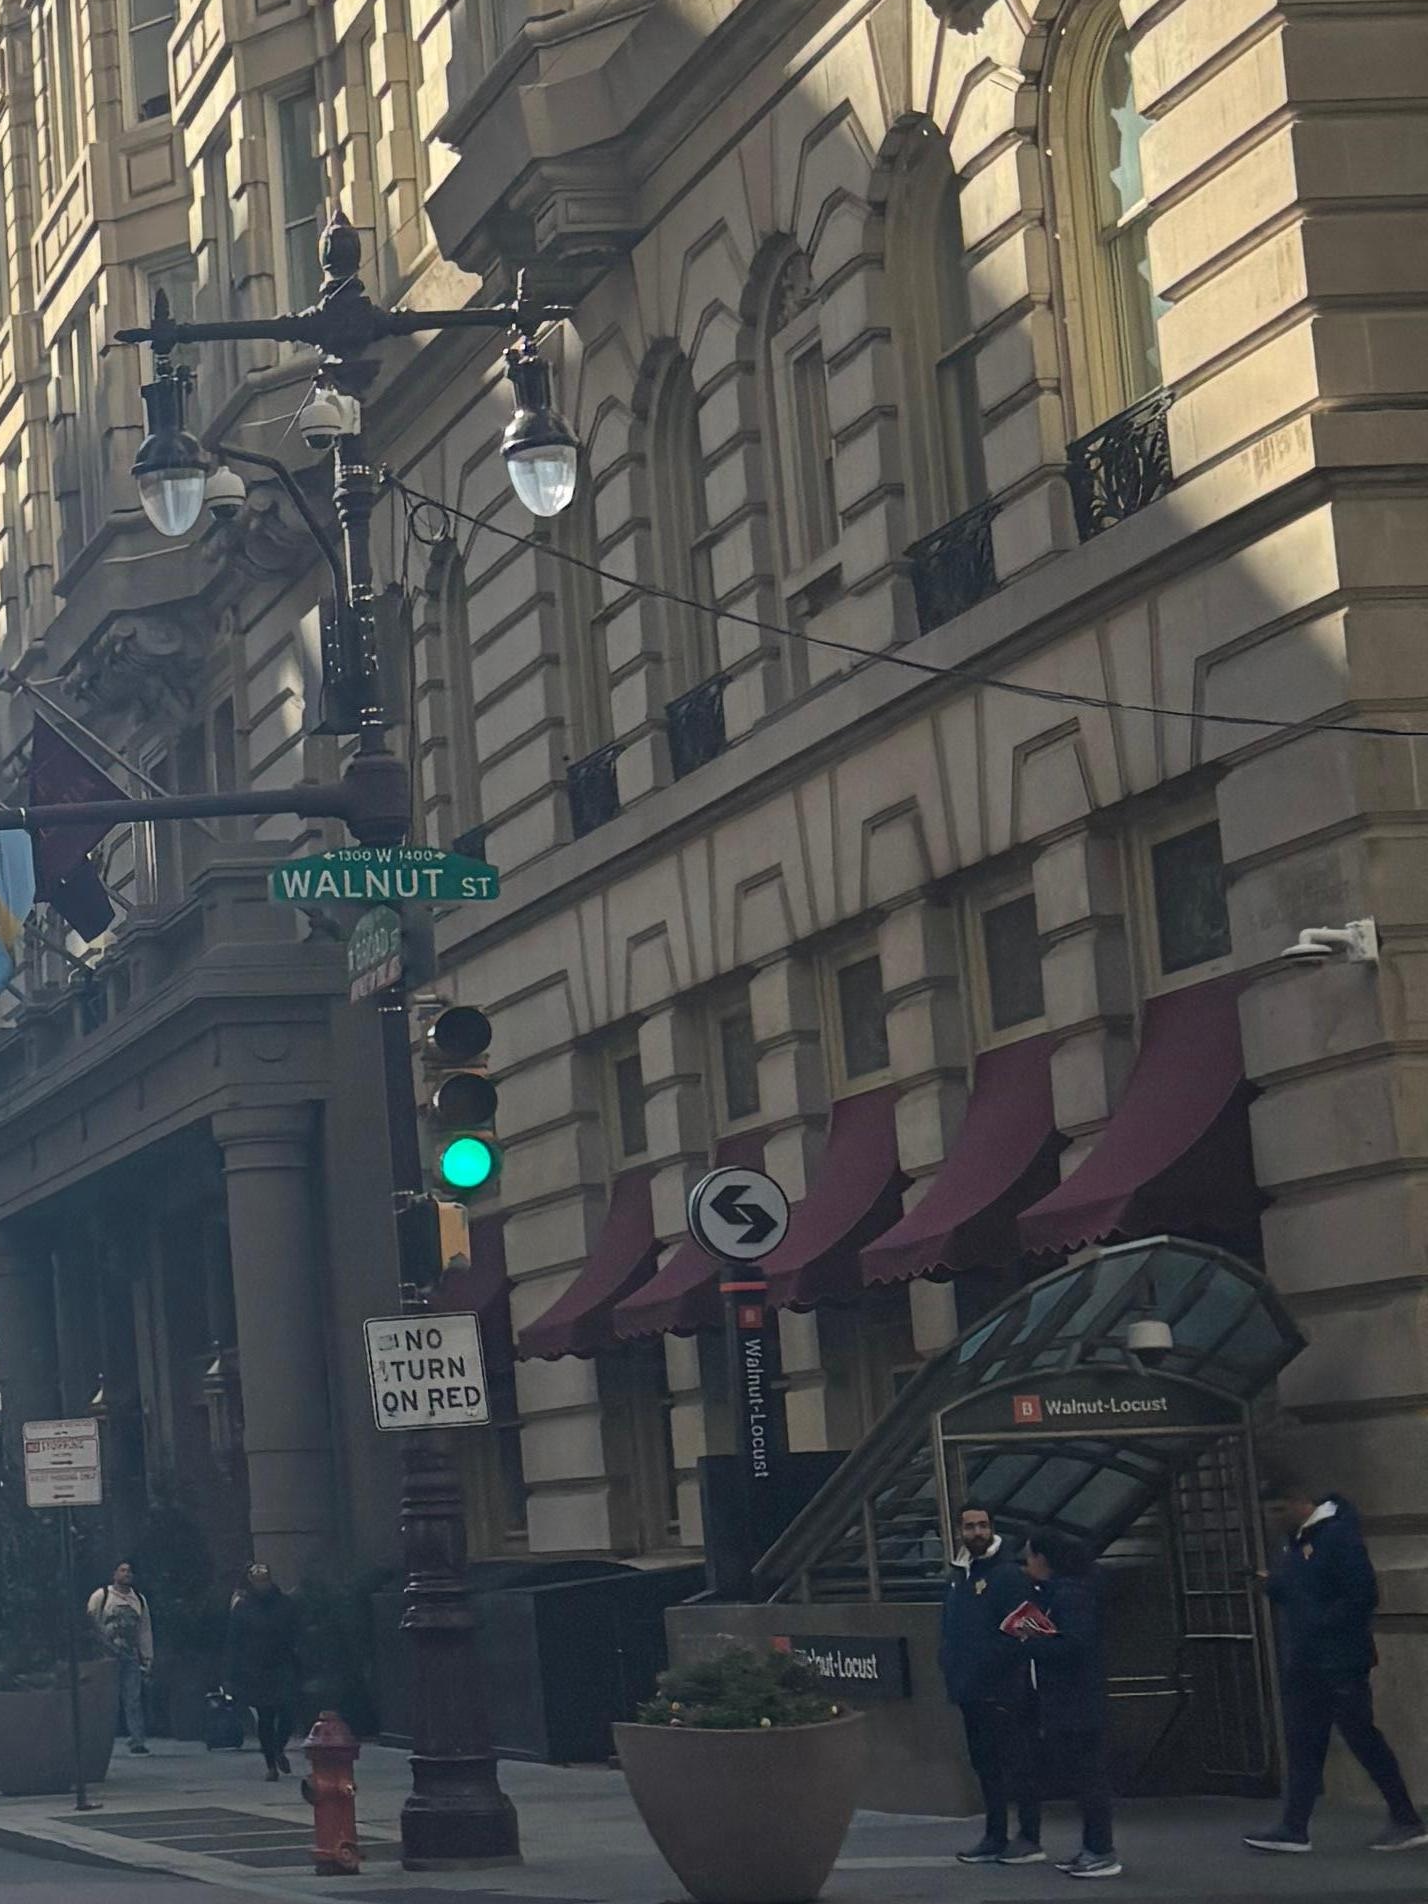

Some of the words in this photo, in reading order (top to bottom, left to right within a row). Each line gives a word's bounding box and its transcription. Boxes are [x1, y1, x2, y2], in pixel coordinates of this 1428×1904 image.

[338, 850, 371, 861] 1300
[375, 849, 392, 863] W
[399, 849, 432, 861] 1400
[281, 869, 443, 898] WALNUT
[461, 877, 491, 897] ST
[405, 1328, 442, 1351] NO
[390, 1356, 465, 1382] TURN
[382, 1389, 418, 1412] ON
[428, 1386, 481, 1409] RED
[745, 1338, 769, 1477] Walnut-Locust
[1045, 1397, 1168, 1416] Walnut-Locust
